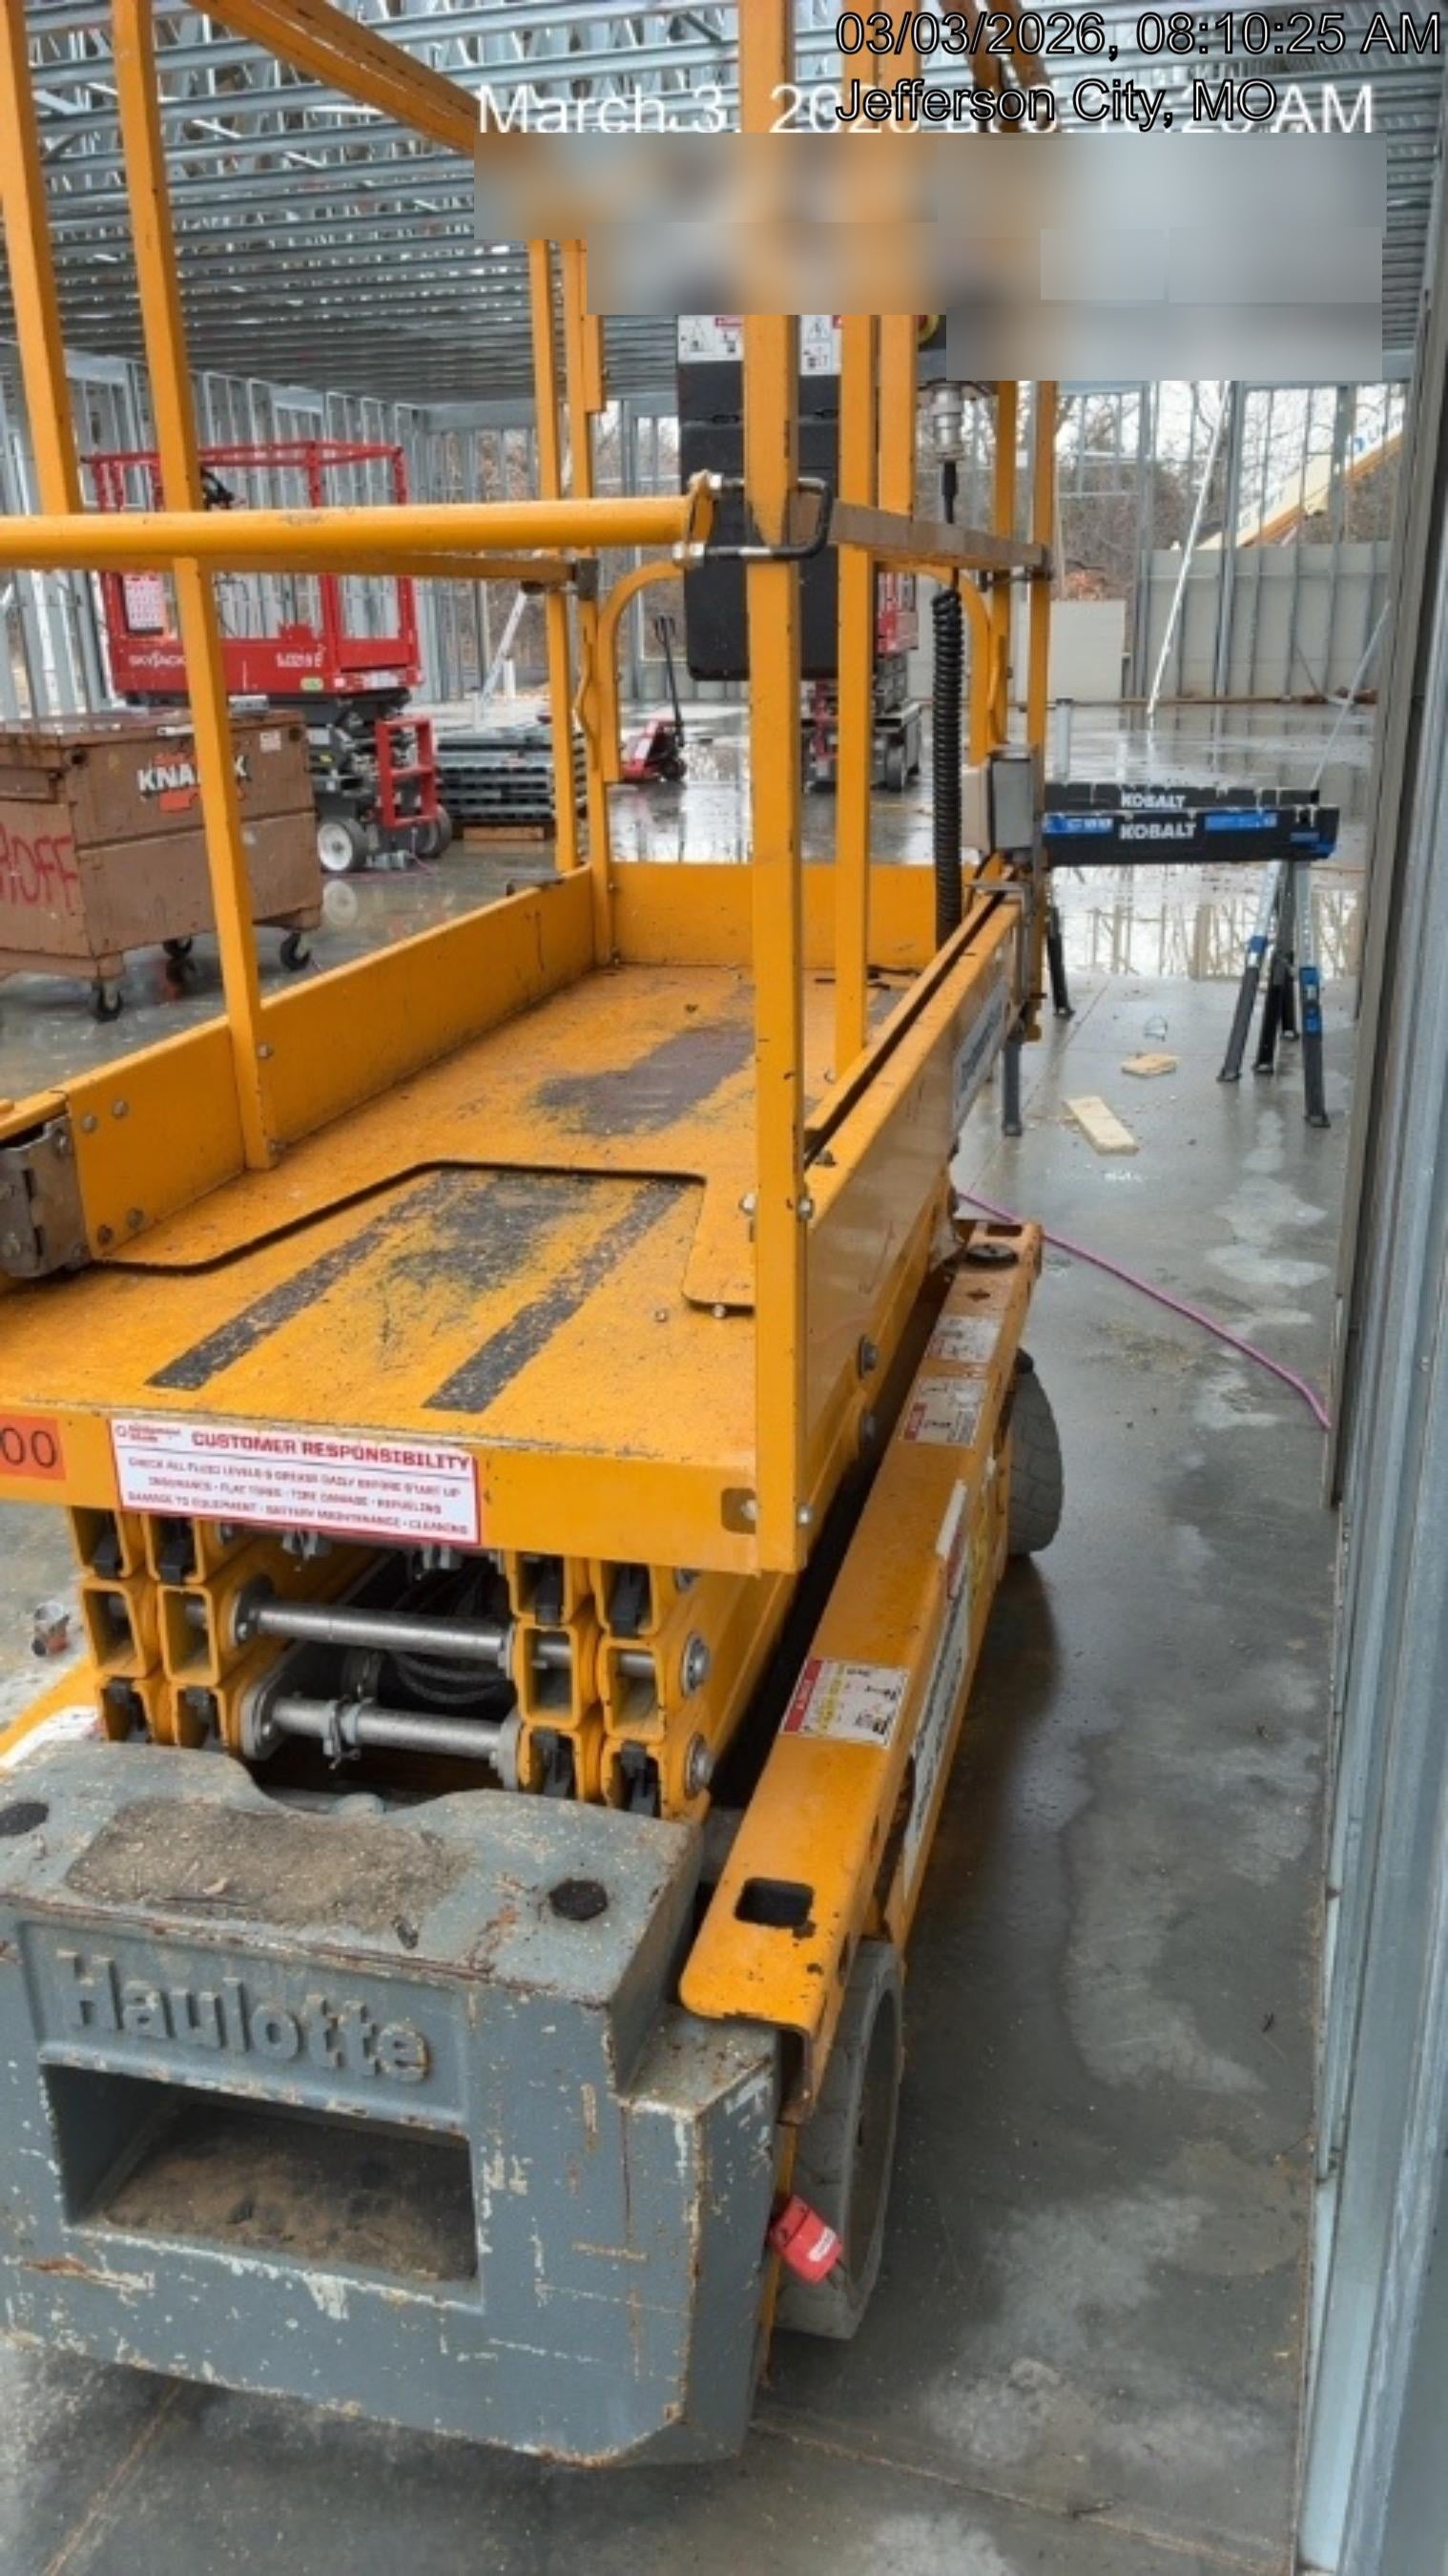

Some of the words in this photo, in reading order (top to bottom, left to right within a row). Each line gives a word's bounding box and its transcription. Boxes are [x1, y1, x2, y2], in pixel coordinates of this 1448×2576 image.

[137, 756, 246, 791] KNAK
[1121, 793, 1186, 808] KOBALT
[1120, 821, 1197, 840] KOBALT
[193, 1431, 296, 1454] CUSTOMER
[302, 1443, 469, 1470] RESPONSIBILITY
[56, 1947, 432, 2084] Haulotte
